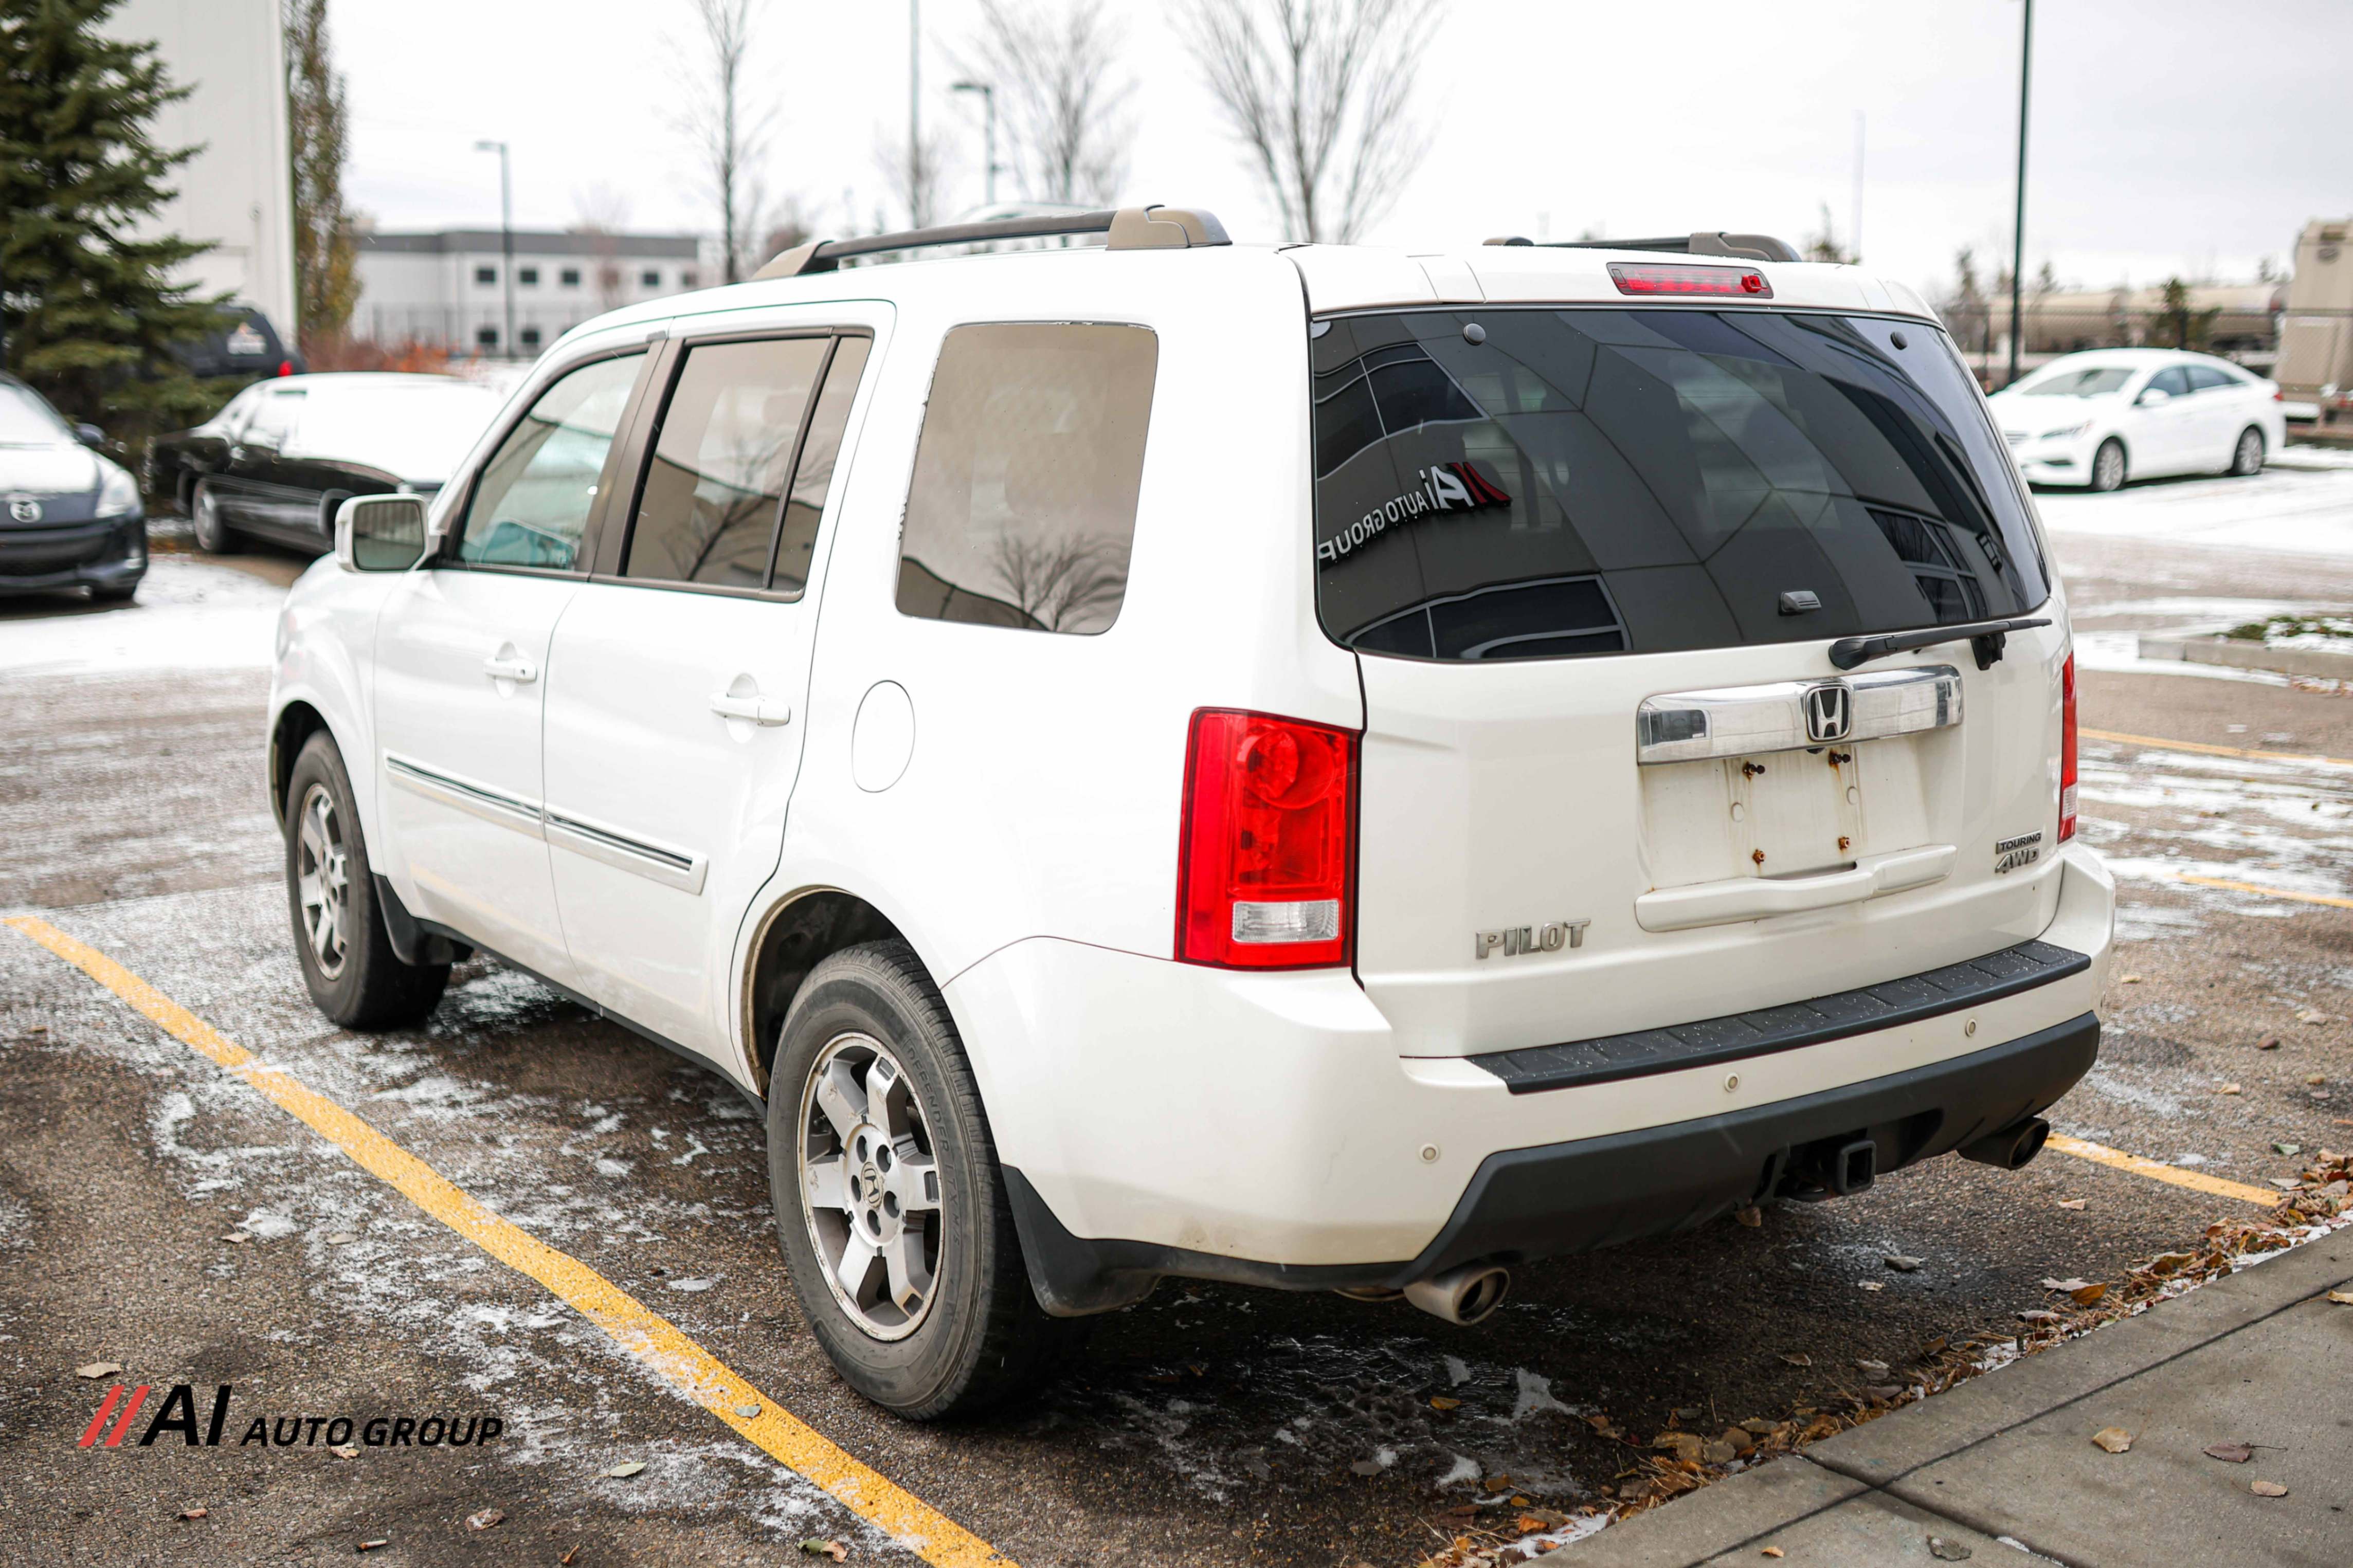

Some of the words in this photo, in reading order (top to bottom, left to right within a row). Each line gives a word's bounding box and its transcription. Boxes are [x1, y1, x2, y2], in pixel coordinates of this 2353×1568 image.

[2000, 832, 2041, 851] TOURING
[1995, 846, 2040, 874] 4WD
[1475, 918, 1591, 960] PILOT
[907, 1047, 950, 1153] DEFENDER
[945, 1163, 958, 1206] LTX
